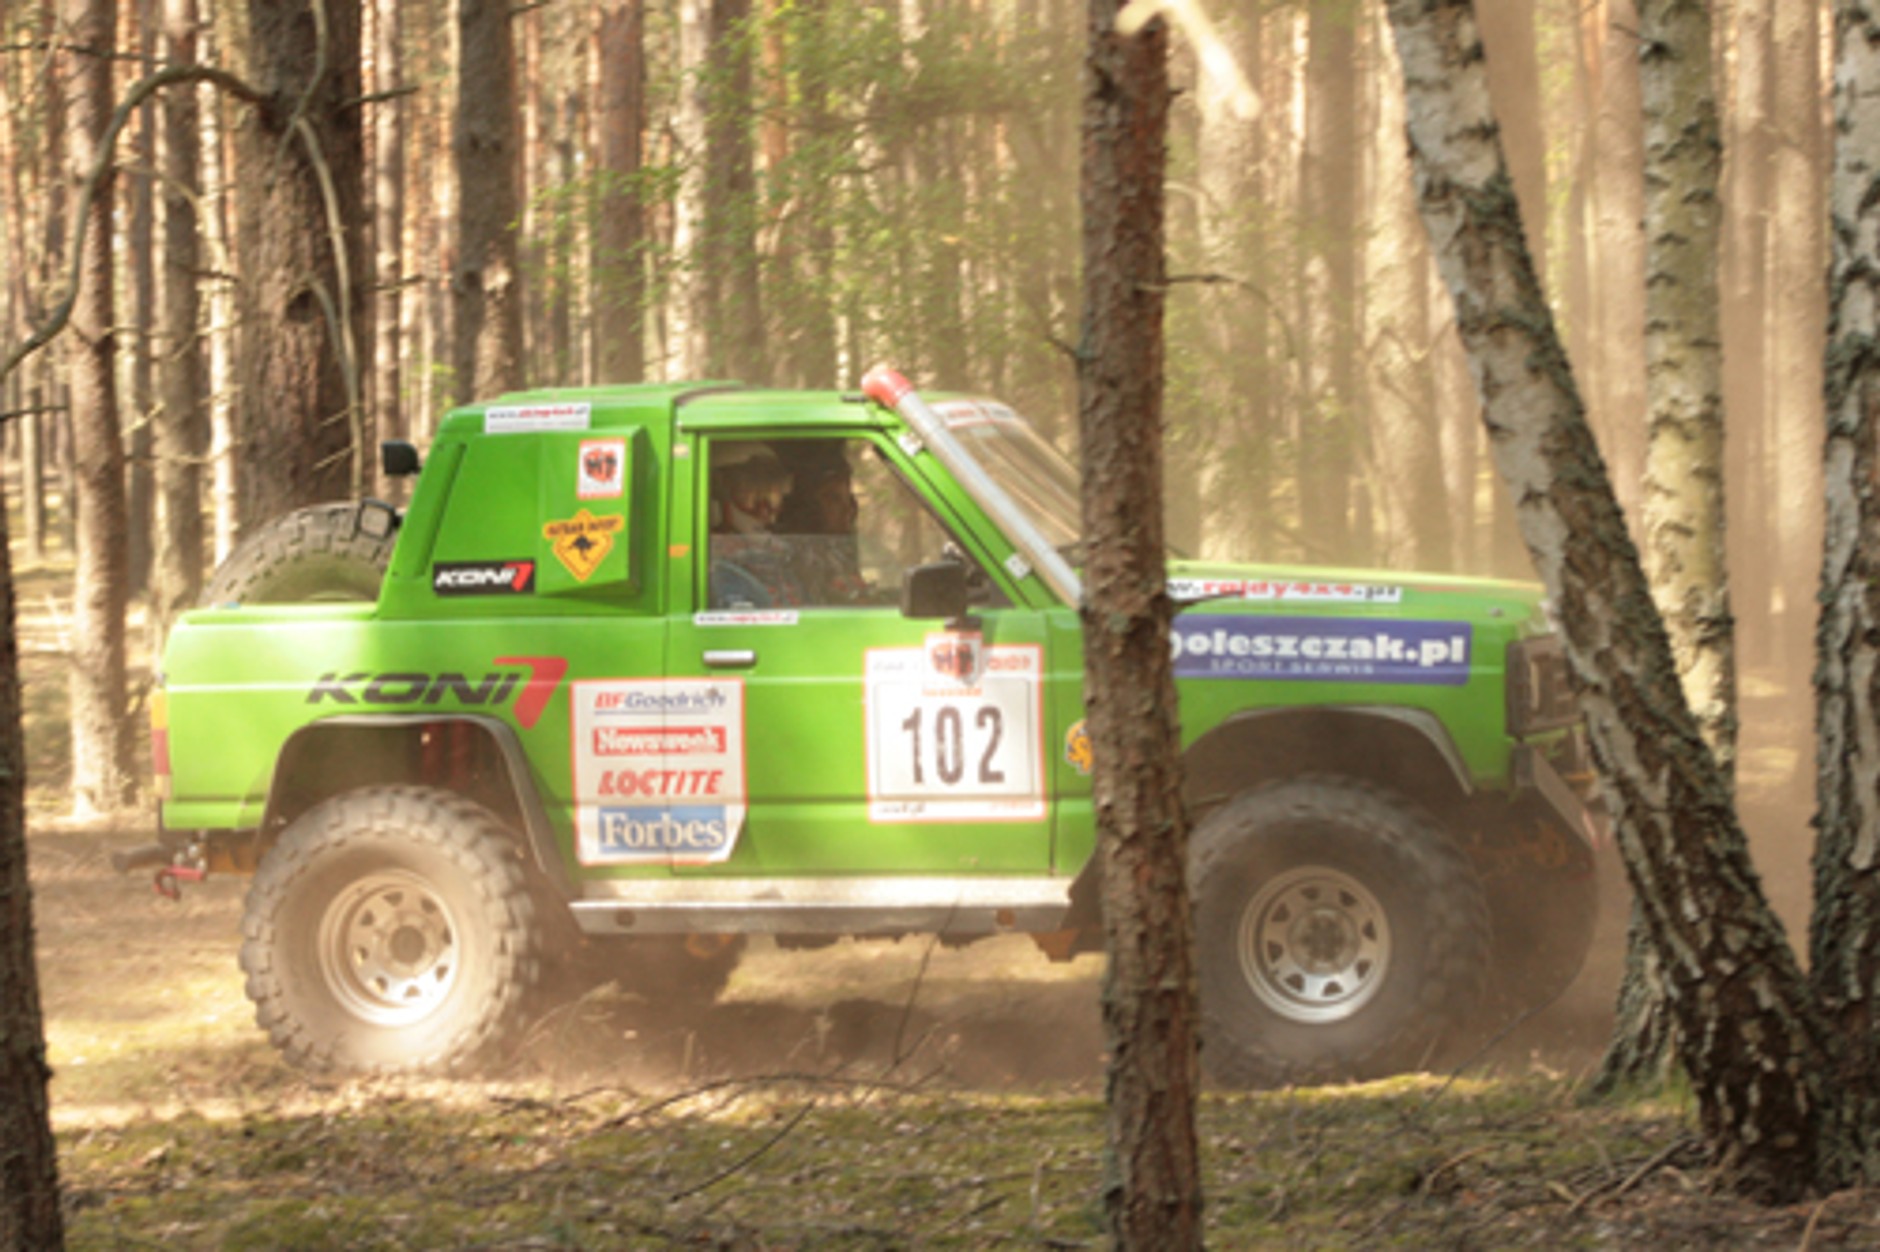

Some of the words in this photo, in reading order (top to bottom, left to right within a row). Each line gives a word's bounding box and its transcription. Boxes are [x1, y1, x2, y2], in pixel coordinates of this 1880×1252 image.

[598, 727, 718, 754] Newsweek
[902, 705, 1006, 785] 102
[597, 770, 724, 797] LOCTITE
[602, 810, 725, 849] Forbes
